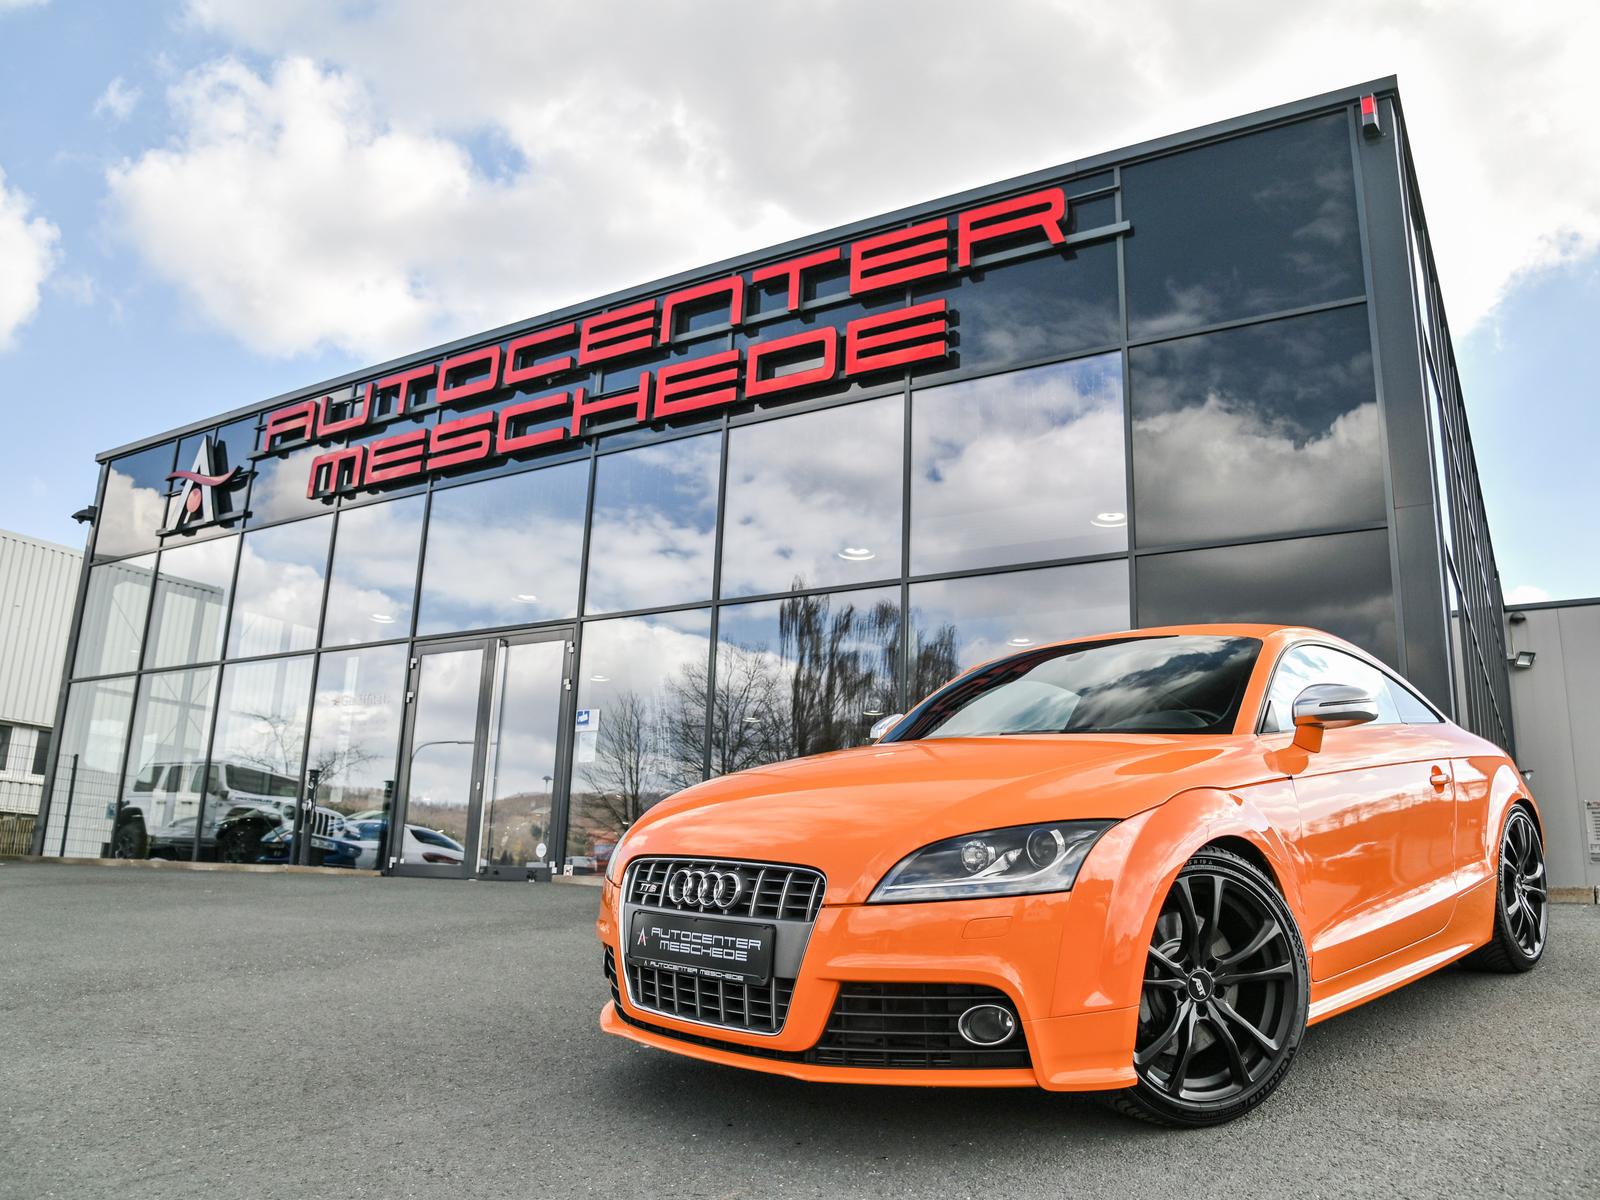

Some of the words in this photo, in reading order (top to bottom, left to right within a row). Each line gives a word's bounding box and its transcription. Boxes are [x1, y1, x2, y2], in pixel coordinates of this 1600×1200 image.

[264, 187, 1067, 452] AUTOCENTER
[307, 299, 949, 499] MESCHEDE
[651, 927, 761, 950] AUTOCENTER
[660, 940, 748, 961] MESCHEDE
[650, 961, 698, 974] AUTOCENTER
[699, 970, 744, 981] MESCHEDE
[1249, 1059, 1289, 1104] MICHELIN
